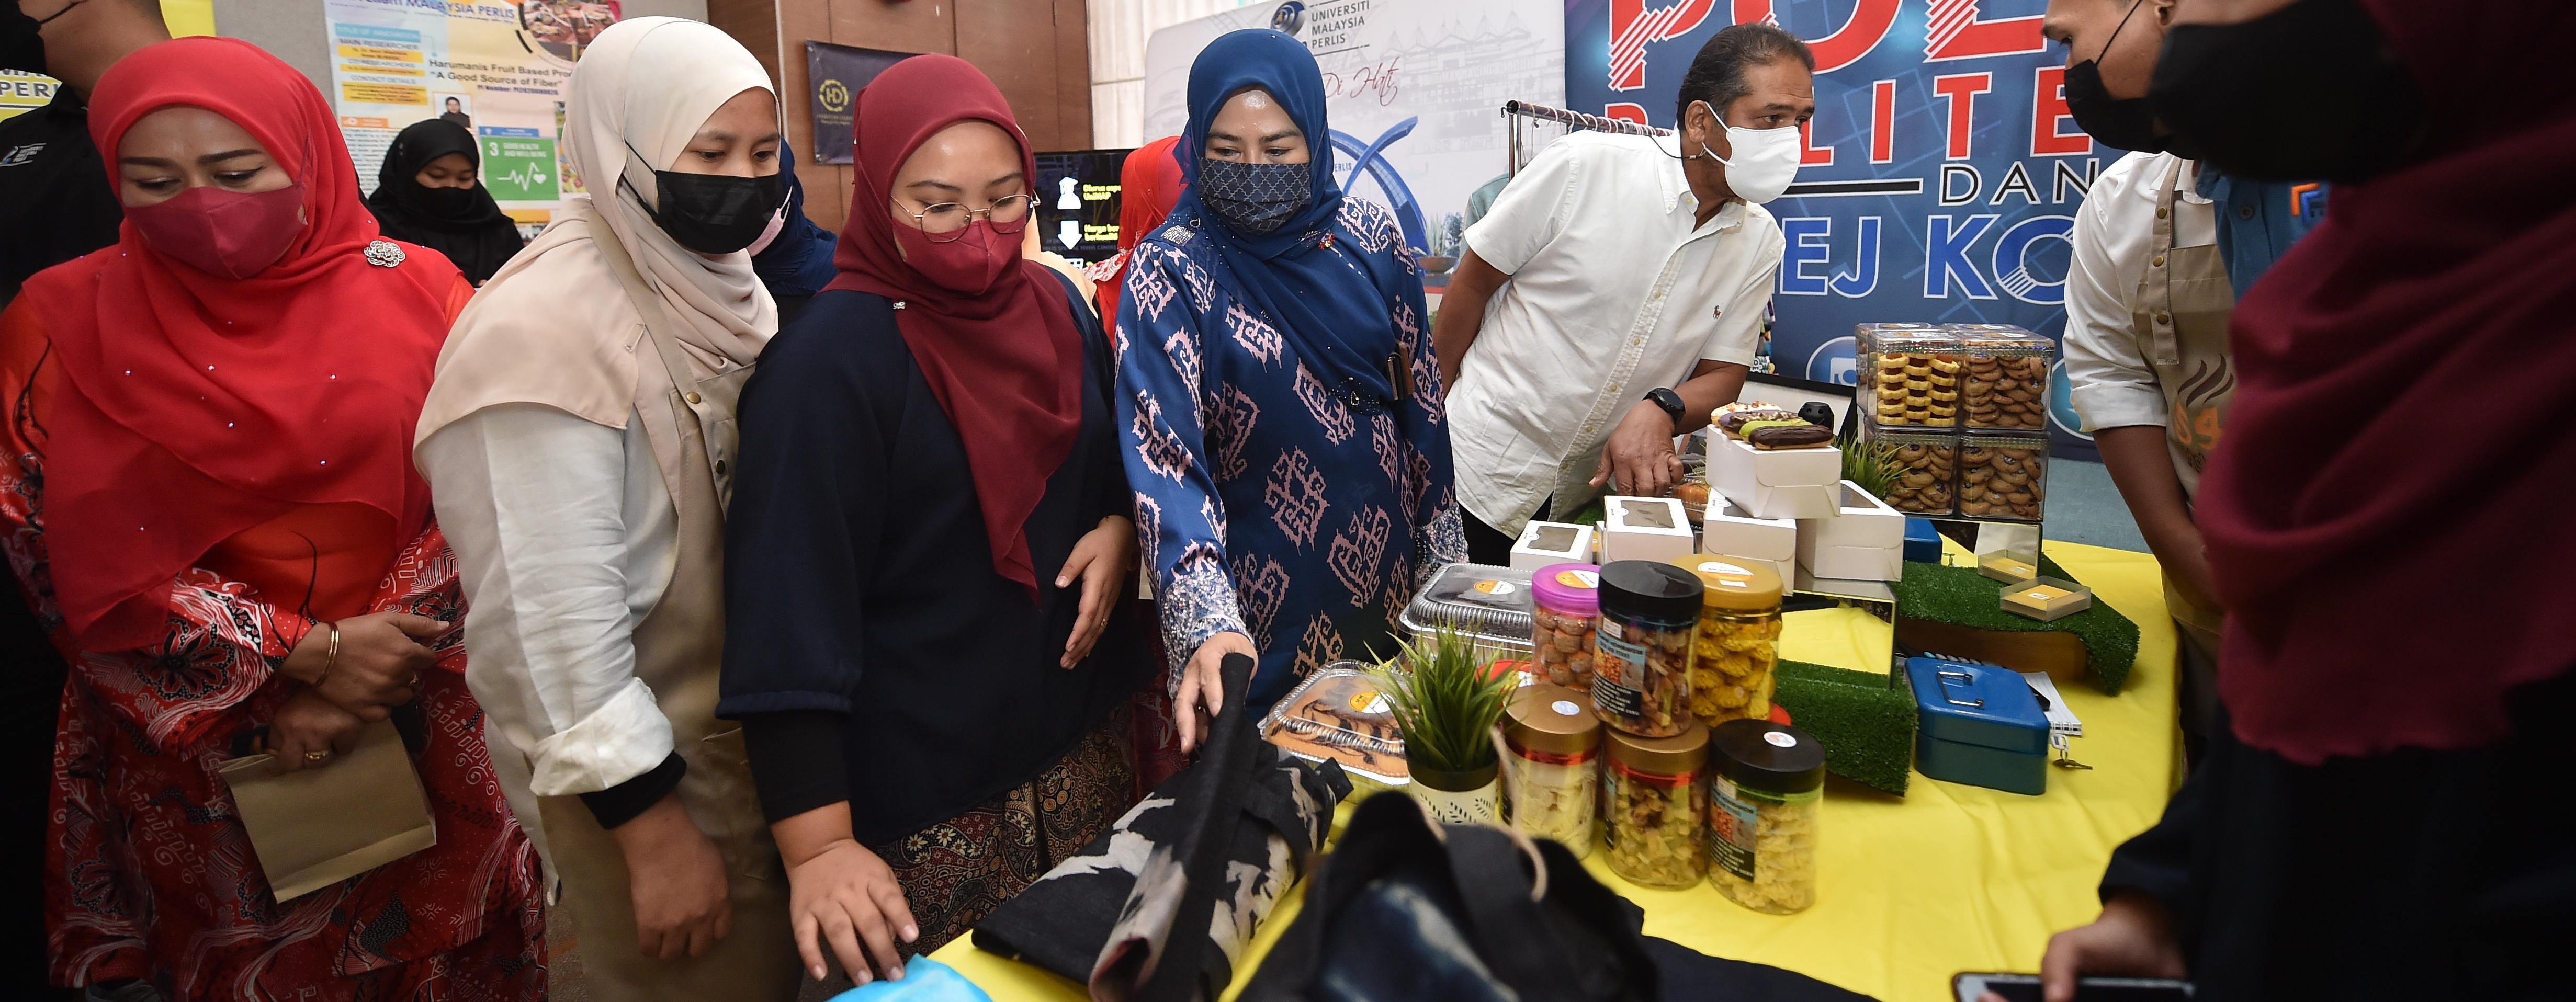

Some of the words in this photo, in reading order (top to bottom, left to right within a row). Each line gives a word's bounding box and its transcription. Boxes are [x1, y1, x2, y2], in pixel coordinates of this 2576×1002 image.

[478, 6, 515, 19] PERLIS
[1311, 1, 1370, 22] UNIVERSITI
[1311, 16, 1365, 36] MALAYSIA
[1312, 33, 1346, 49] PERLIS
[491, 63, 515, 73] Fruit
[518, 66, 549, 76] Based
[447, 72, 477, 82] Good
[480, 74, 517, 84] Source
[520, 76, 530, 85] of
[489, 142, 500, 157] 3
[1938, 157, 2100, 207] DAN
[1772, 215, 1882, 299] EJ
